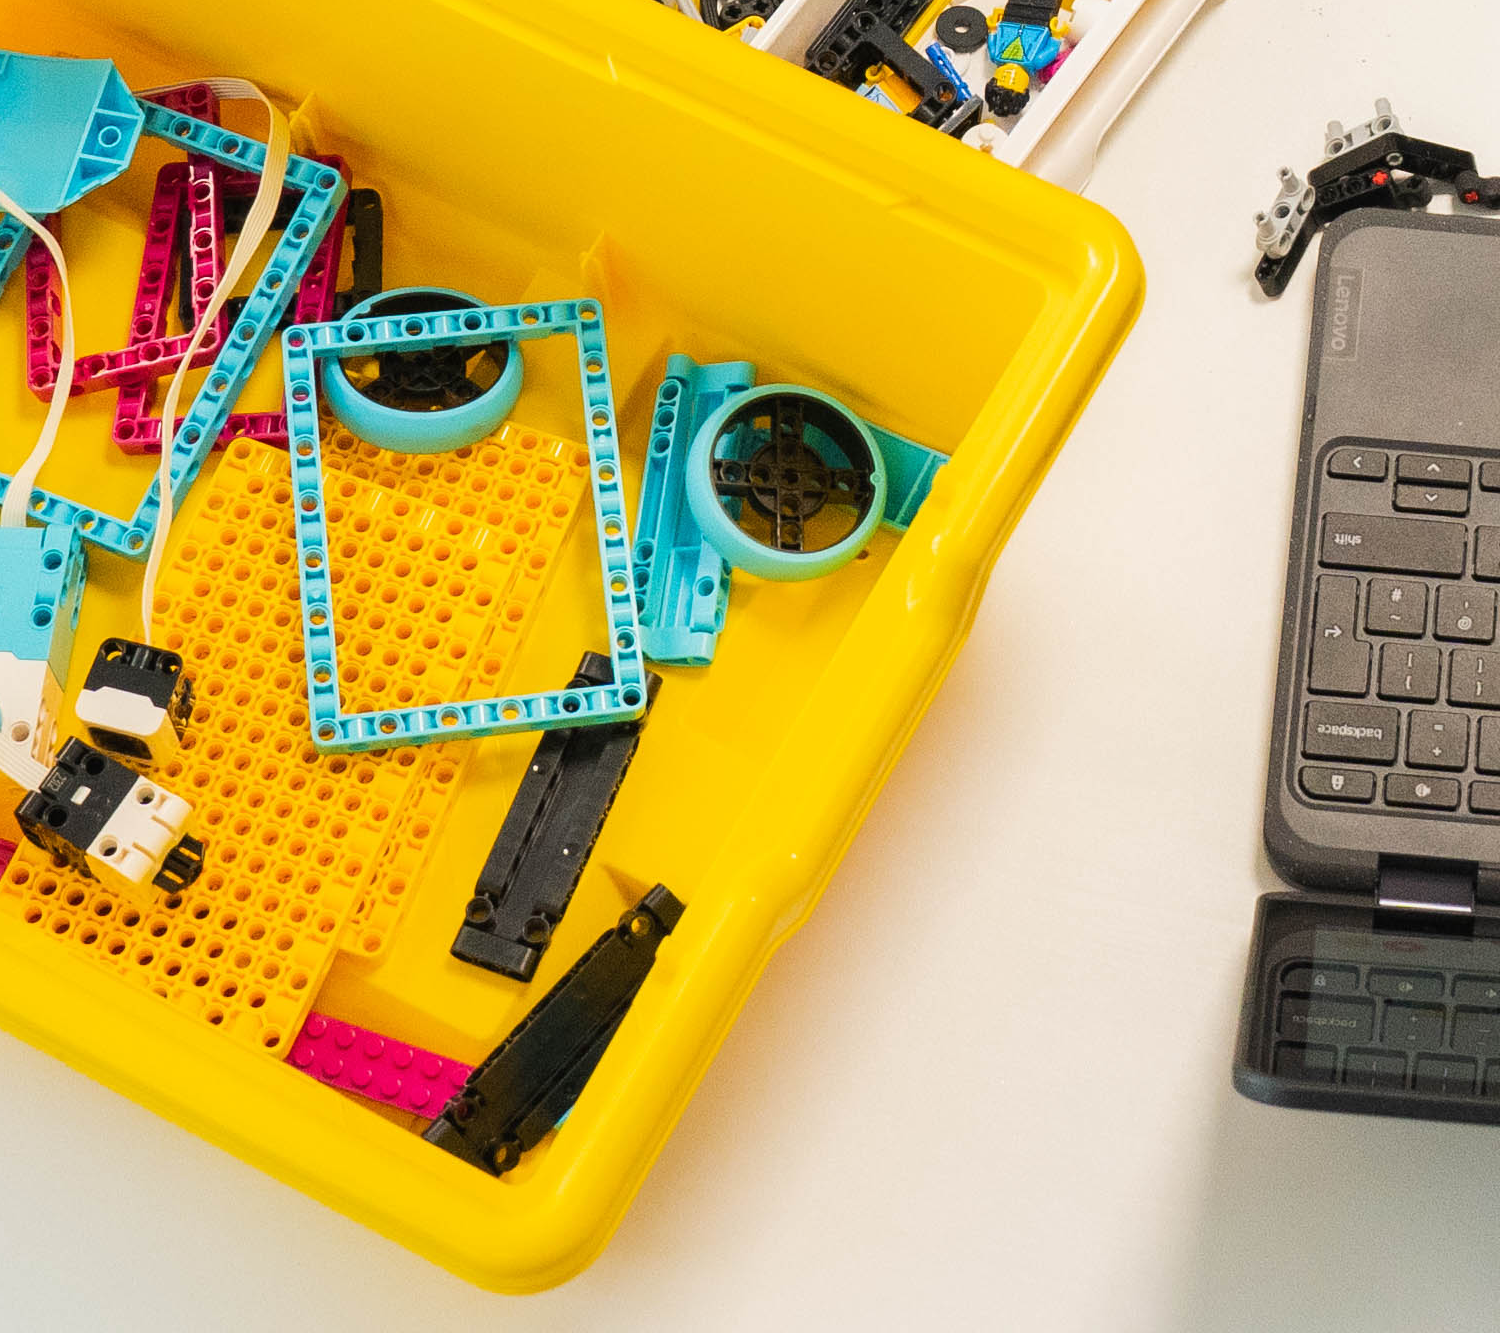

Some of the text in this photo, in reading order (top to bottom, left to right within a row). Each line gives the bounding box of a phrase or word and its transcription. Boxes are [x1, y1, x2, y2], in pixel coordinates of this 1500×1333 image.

[1331, 274, 1356, 351] Lenovo
[1334, 533, 1362, 545] shift
[1317, 724, 1382, 740] backspace
